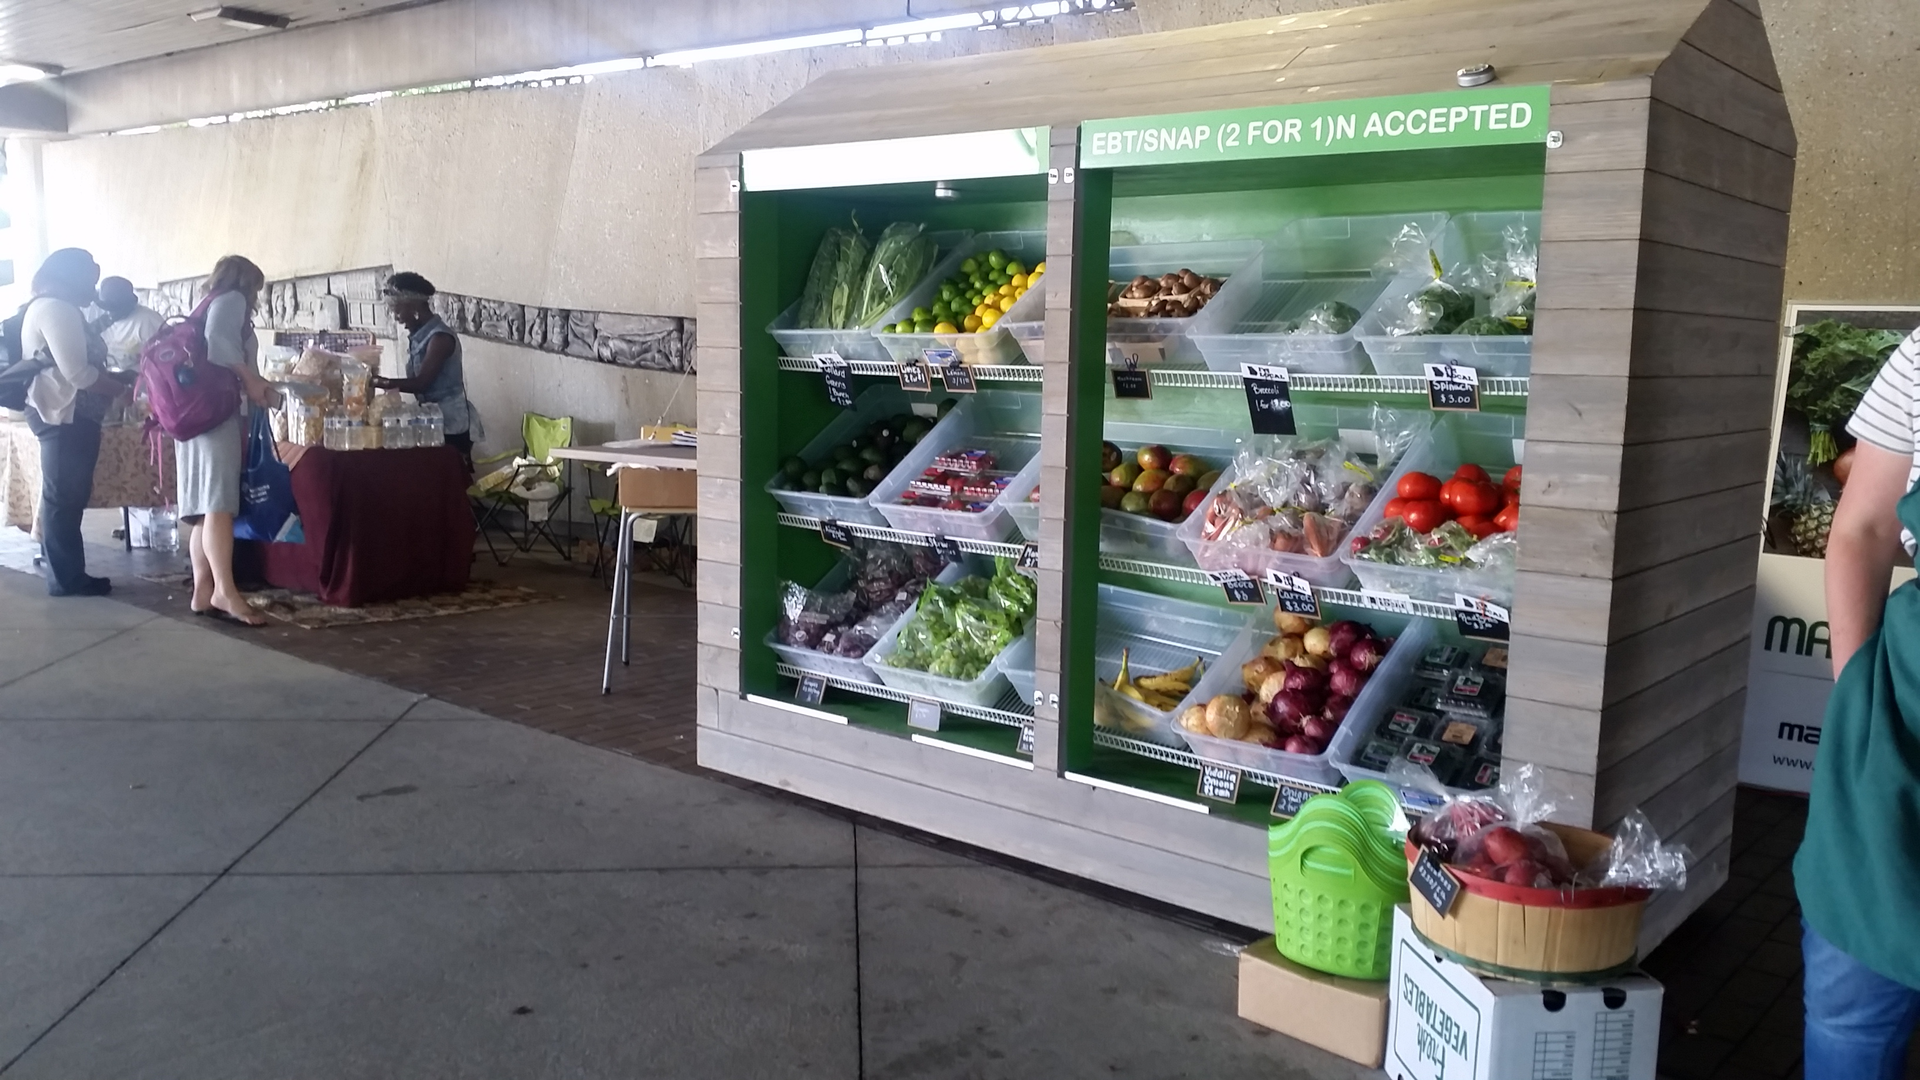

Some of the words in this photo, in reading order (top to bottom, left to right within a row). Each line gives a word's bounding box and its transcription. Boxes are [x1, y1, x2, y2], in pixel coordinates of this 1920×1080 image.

[1092, 126, 1210, 155] EBT/SNAP
[1217, 123, 1240, 153] (2
[1248, 118, 1302, 145] FOR
[1310, 114, 1356, 147] 1)N
[1363, 102, 1532, 138] ACCEPTED
[1251, 382, 1280, 395] Broccoli
[1432, 380, 1474, 392] Spinach
[1279, 590, 1315, 603] Carrots
[1285, 600, 1315, 613] $3.00
[1764, 615, 1832, 659] MA
[1204, 765, 1236, 783] Vidalia
[1203, 775, 1235, 791] Onions
[1403, 973, 1468, 1061] VEGETABLES
[1417, 1022, 1446, 1080] Fresh
